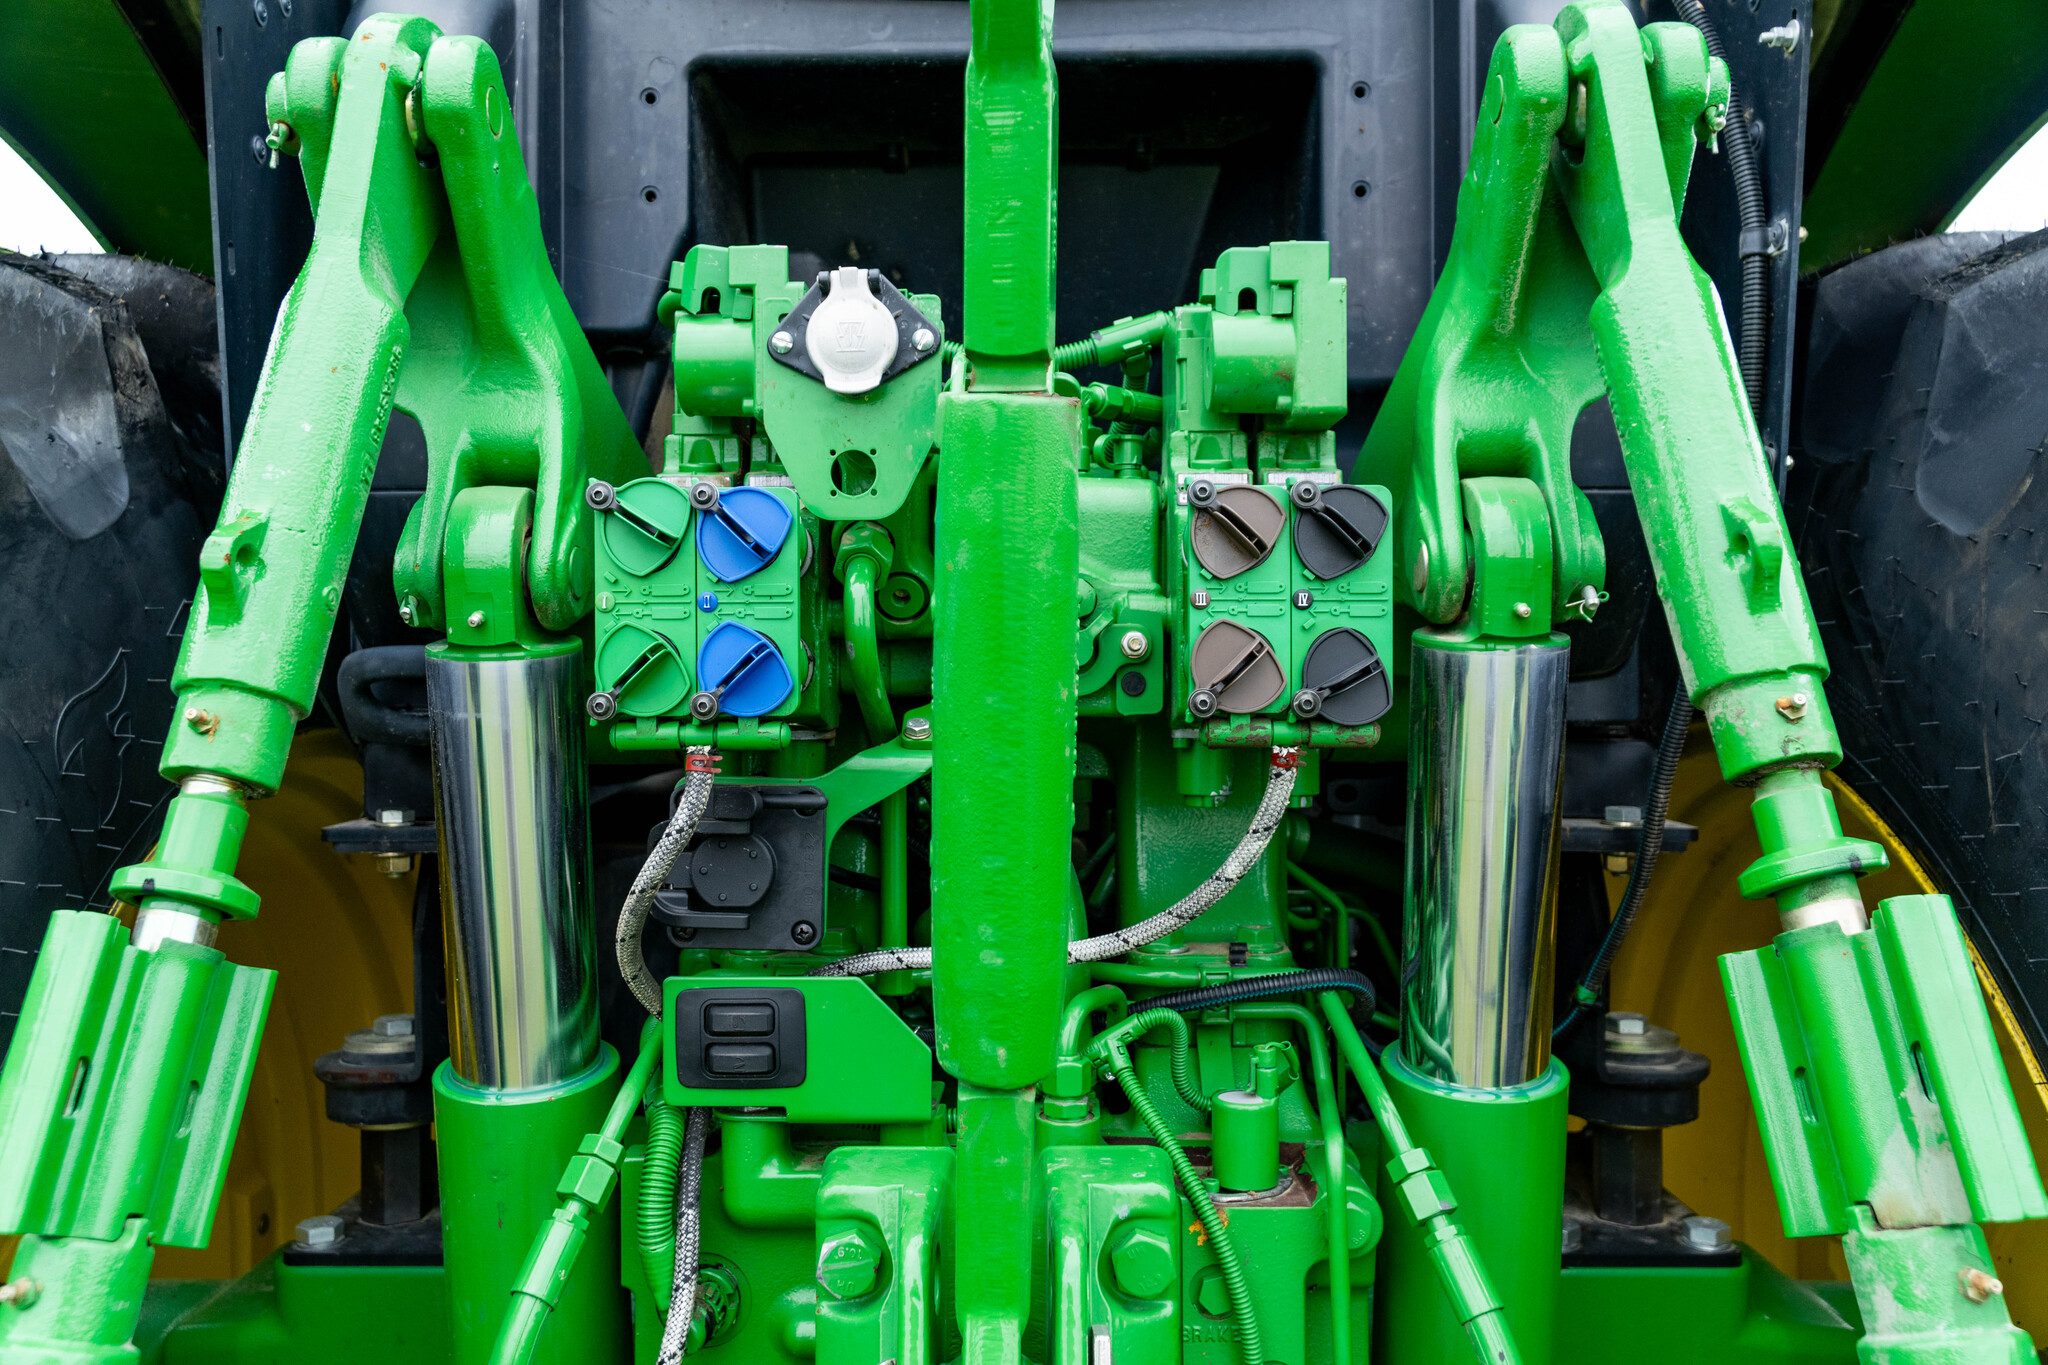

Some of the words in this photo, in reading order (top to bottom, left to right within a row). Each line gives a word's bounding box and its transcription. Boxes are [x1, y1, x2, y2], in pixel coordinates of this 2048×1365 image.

[703, 594, 711, 609] II
[1195, 592, 1207, 606] III
[1297, 592, 1309, 607] IV
